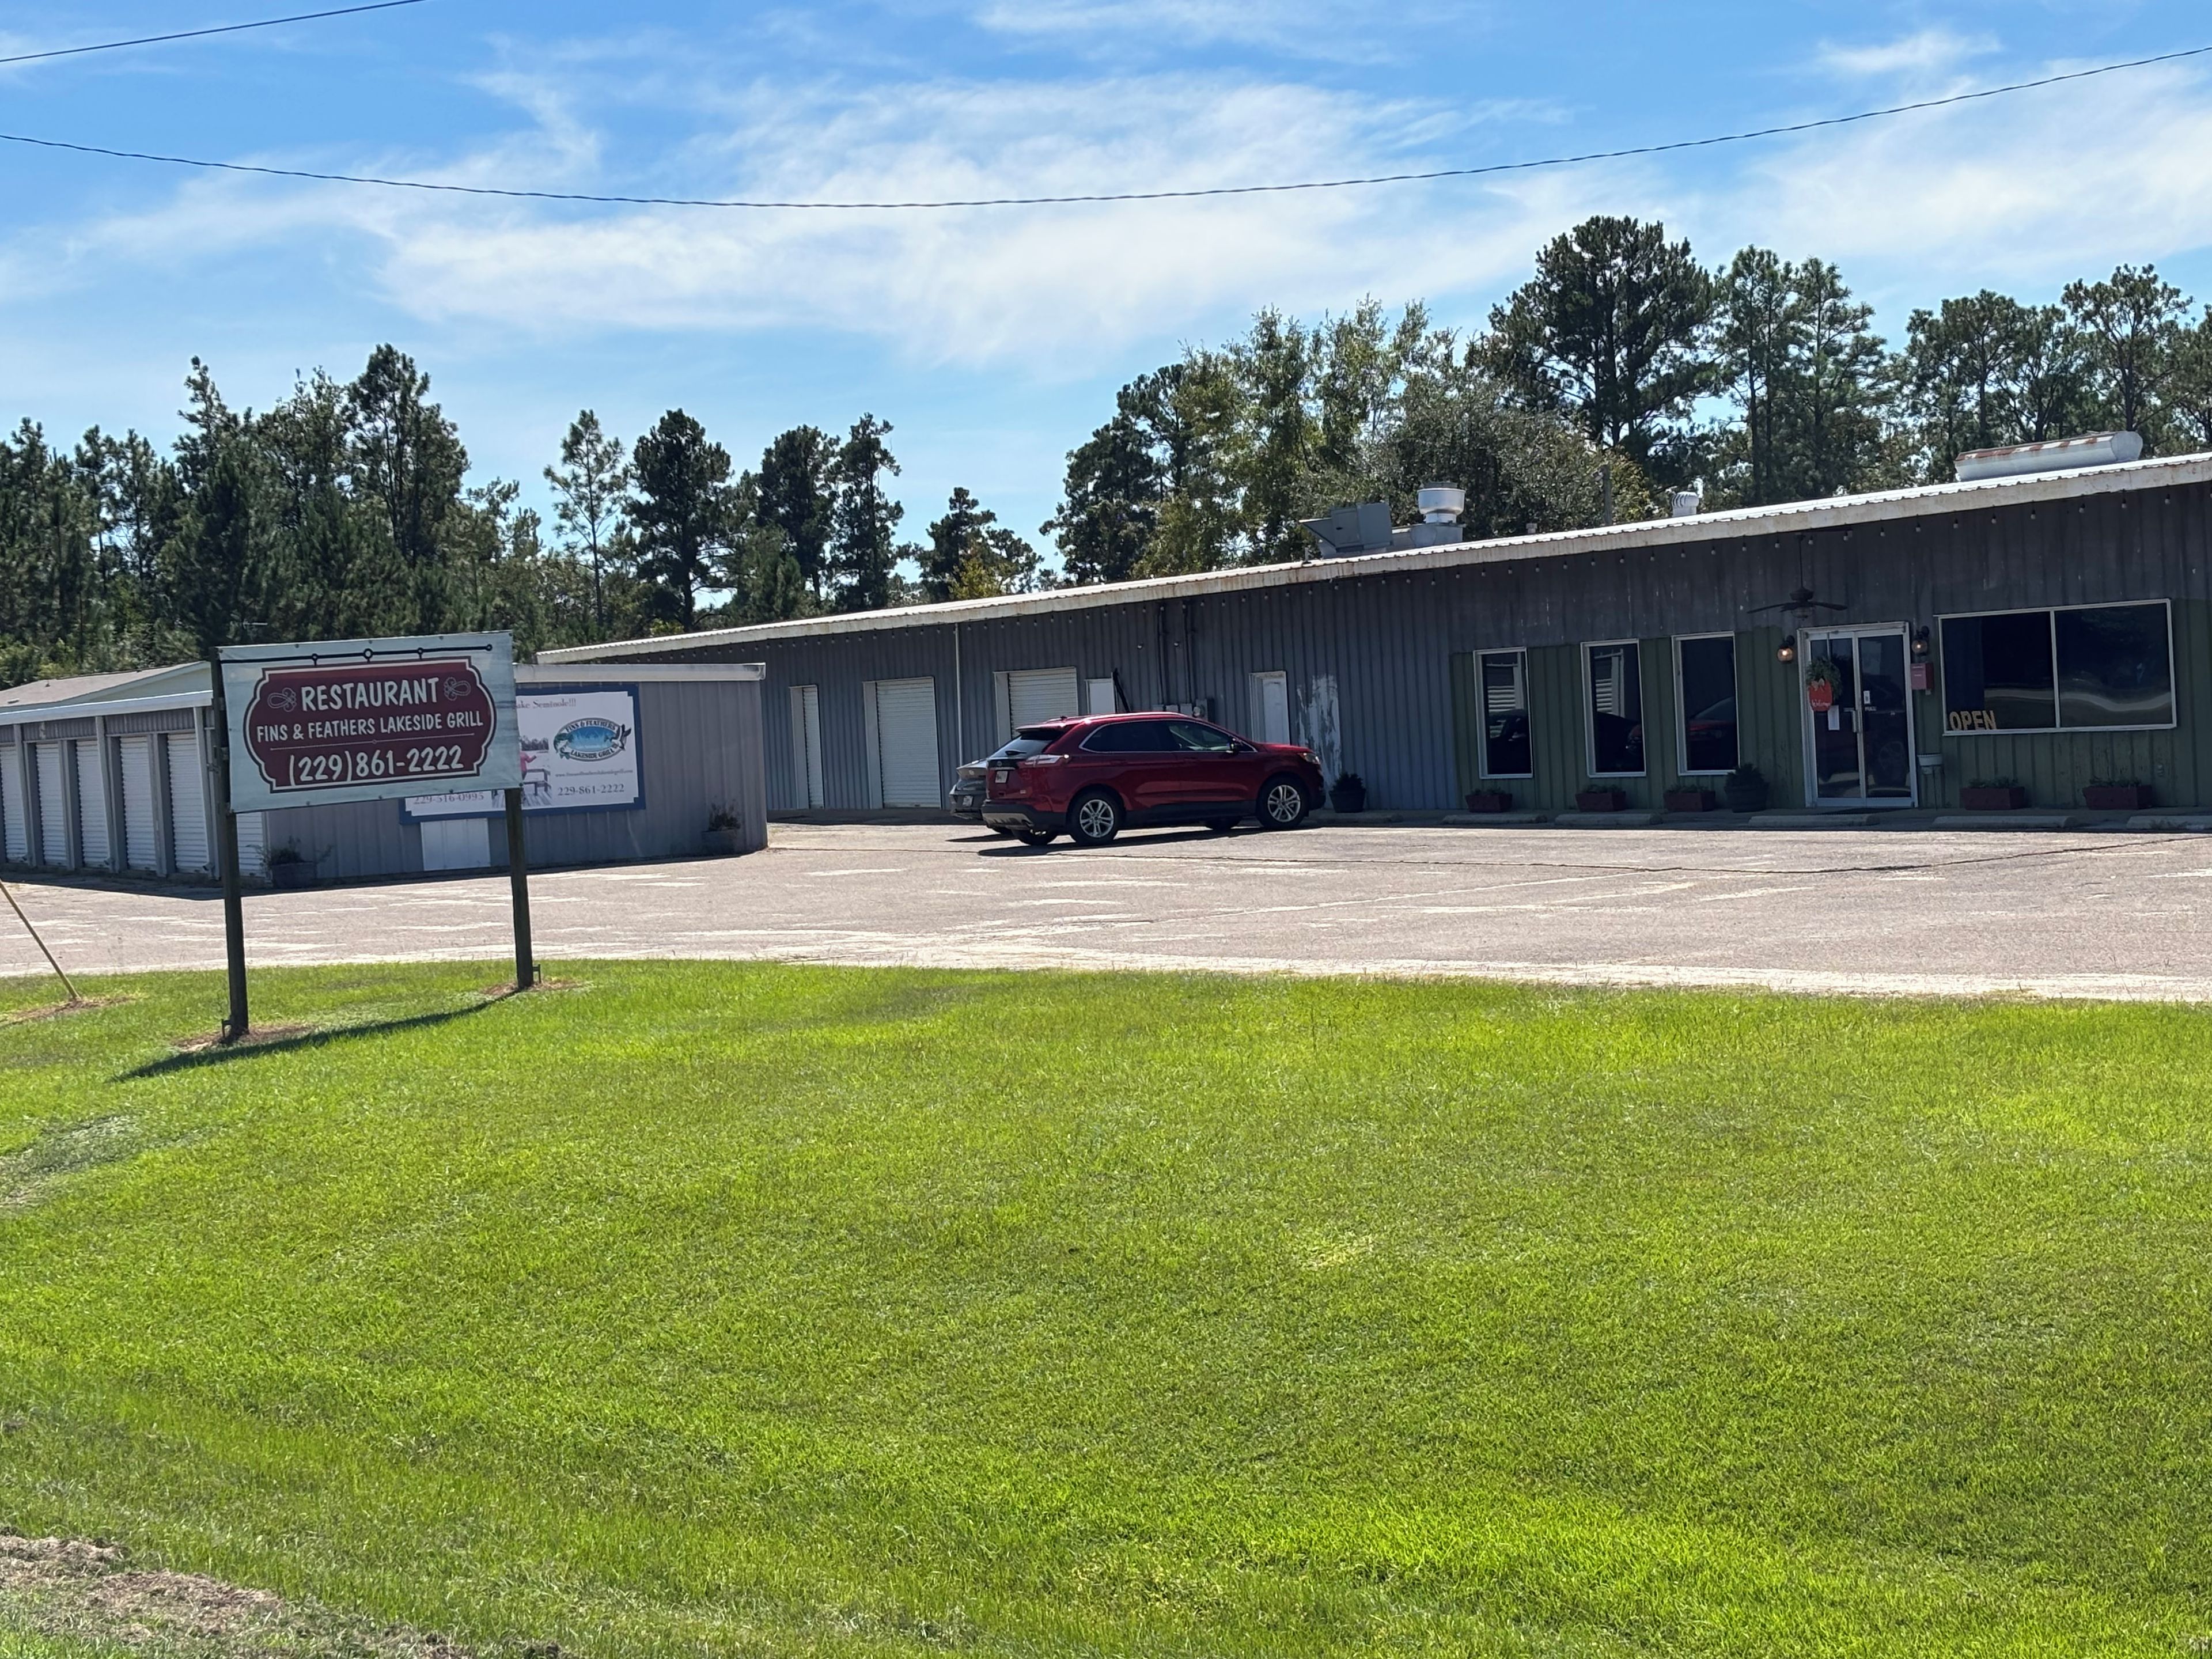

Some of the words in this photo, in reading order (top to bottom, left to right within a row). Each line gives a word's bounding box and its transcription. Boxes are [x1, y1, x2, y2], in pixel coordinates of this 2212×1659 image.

[301, 677, 440, 711] RESTAURANT
[257, 724, 288, 743] FINS
[293, 723, 304, 740] &
[308, 718, 376, 740] FEATHERS
[380, 713, 442, 733] LAKESIDE
[447, 710, 483, 728] GRILL
[586, 720, 616, 730] FEATHERS
[1949, 710, 1997, 730] OPEN
[570, 749, 597, 759] LAKESIDE
[290, 745, 464, 786] (229)861-2222
[558, 783, 624, 796] 229-861-2222
